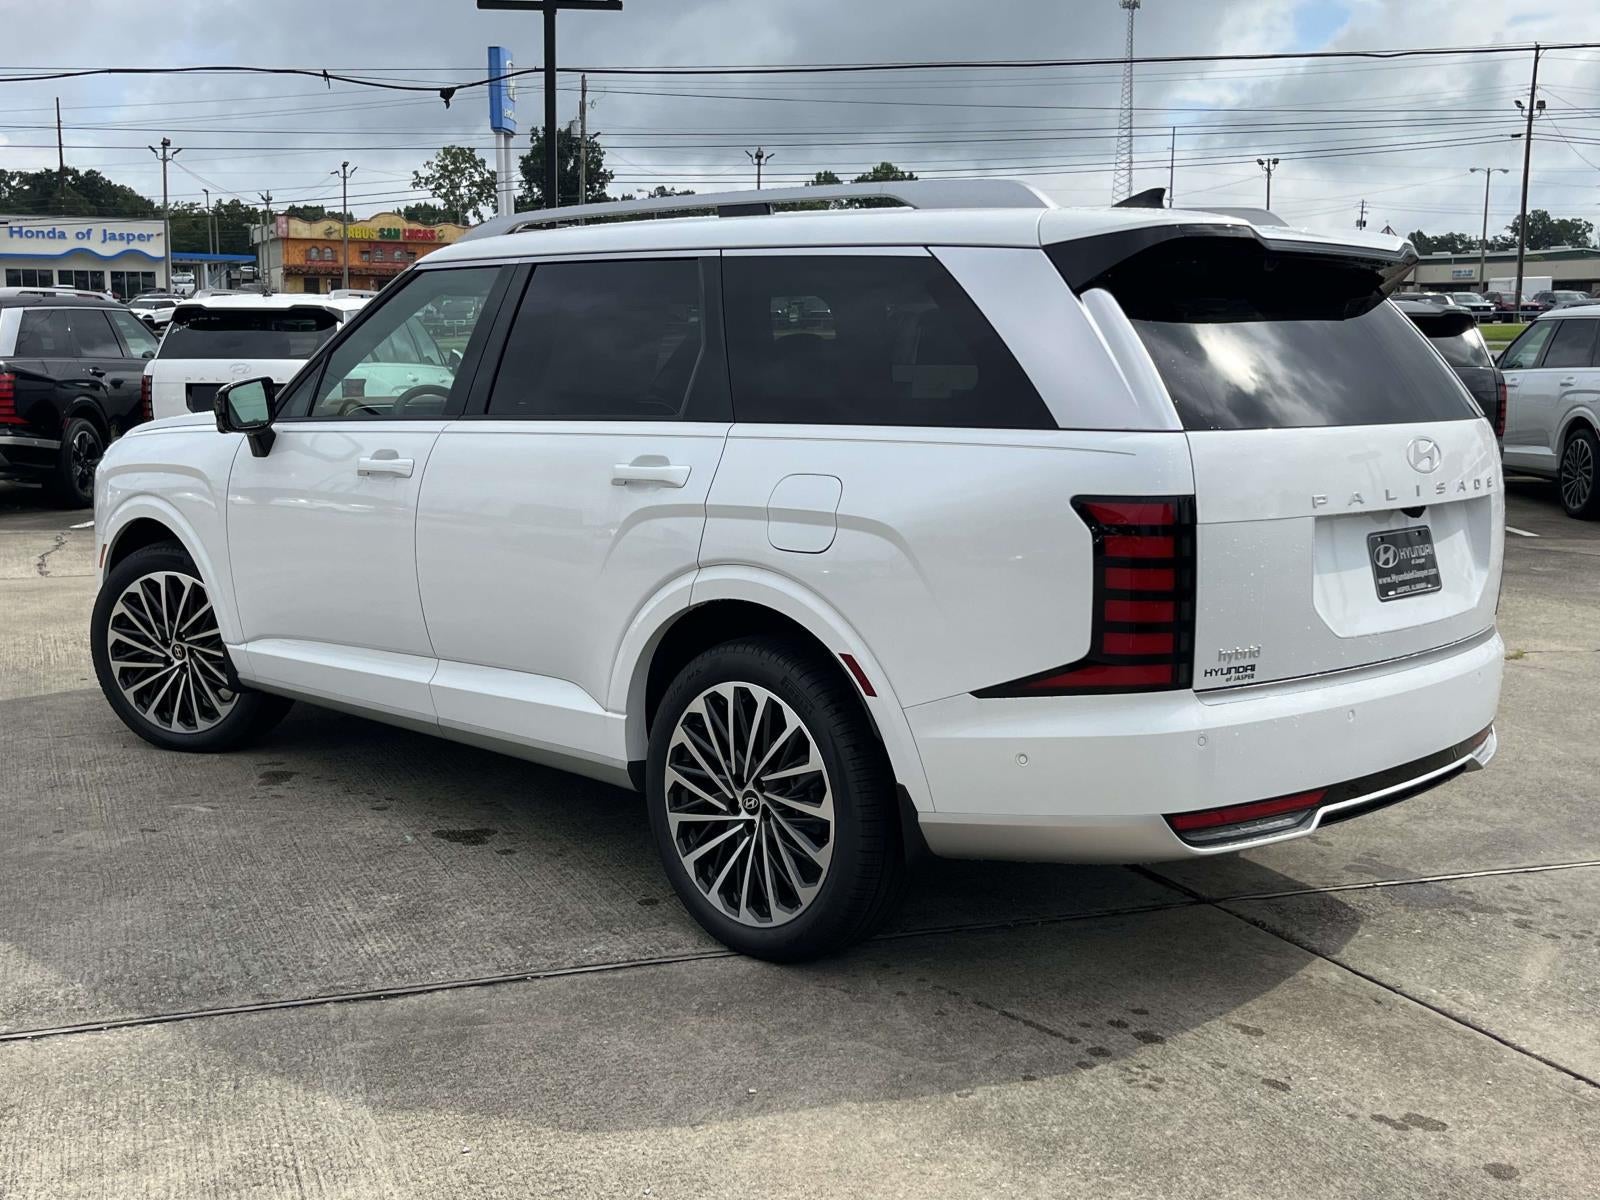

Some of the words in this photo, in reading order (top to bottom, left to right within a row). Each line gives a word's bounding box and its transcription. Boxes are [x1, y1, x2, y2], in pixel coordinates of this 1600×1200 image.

[8, 226, 67, 240] Honda
[75, 228, 93, 240] of
[101, 228, 154, 244] Jasper
[378, 227, 401, 240] SAN
[403, 228, 436, 241] LUCAS
[1312, 476, 1494, 509] PALISADE
[1398, 543, 1434, 560] HYUNDAI
[1218, 644, 1262, 664] hybrid
[1204, 664, 1256, 677] HYUNDAI
[1233, 673, 1255, 681] JASPER
